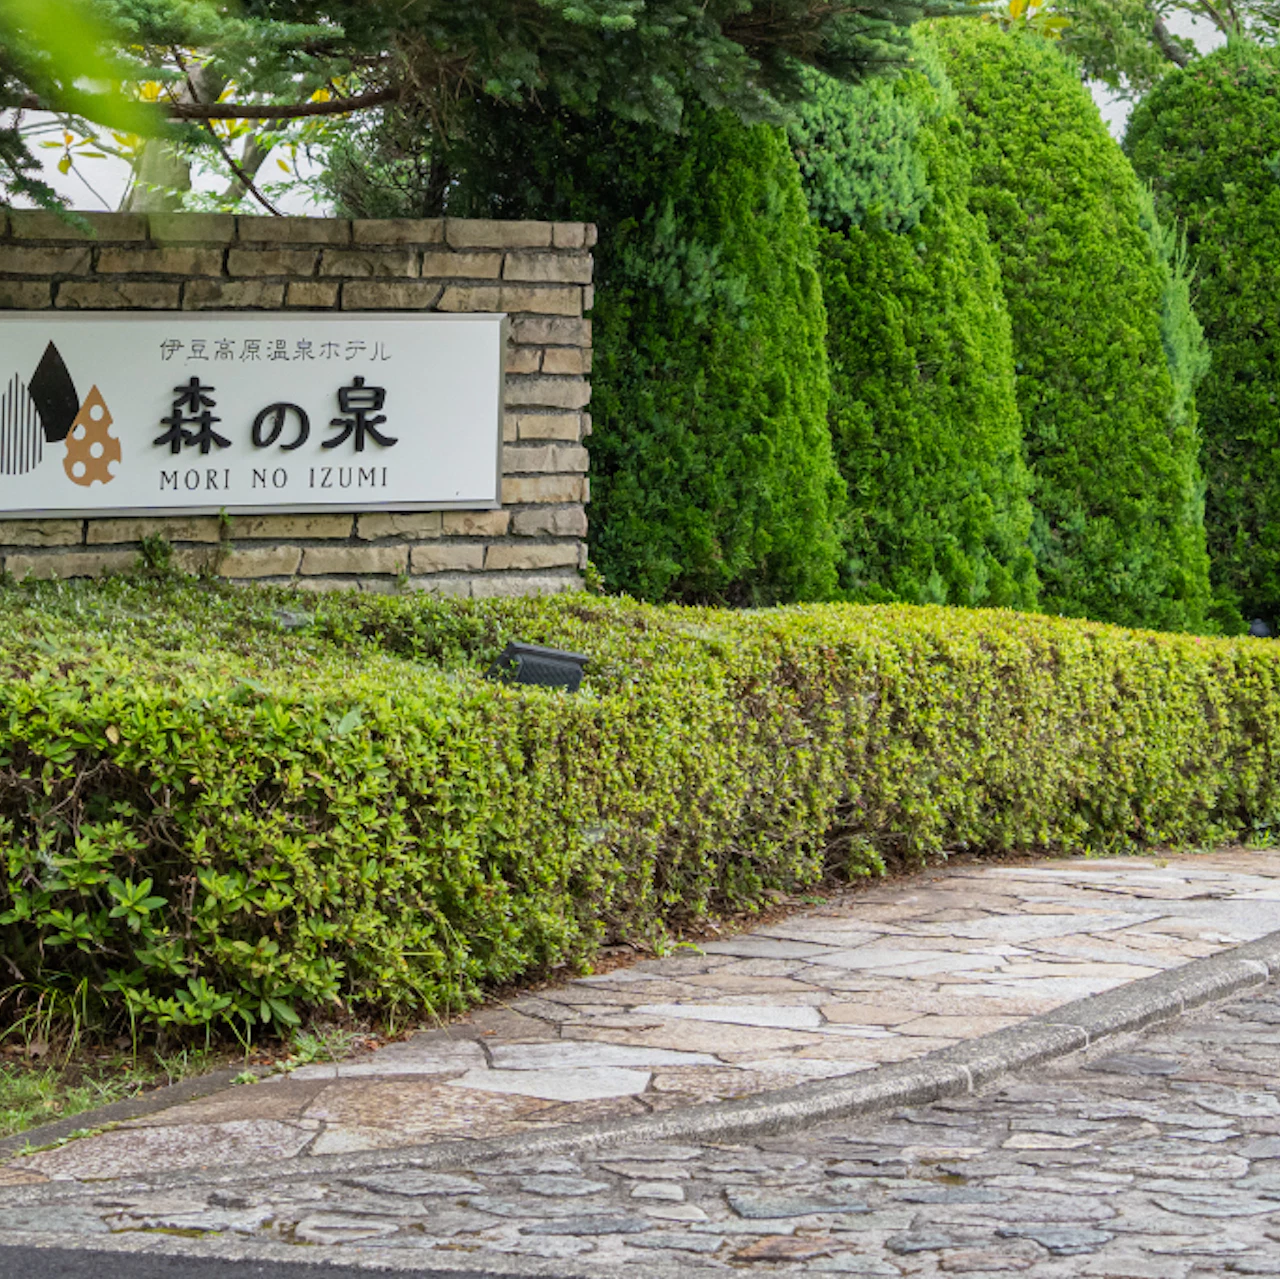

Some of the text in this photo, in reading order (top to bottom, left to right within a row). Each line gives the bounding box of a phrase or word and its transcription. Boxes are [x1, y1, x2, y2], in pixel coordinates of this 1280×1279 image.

[152, 375, 399, 455] 森の泉
[159, 466, 388, 491] MORI NO IZUMI
